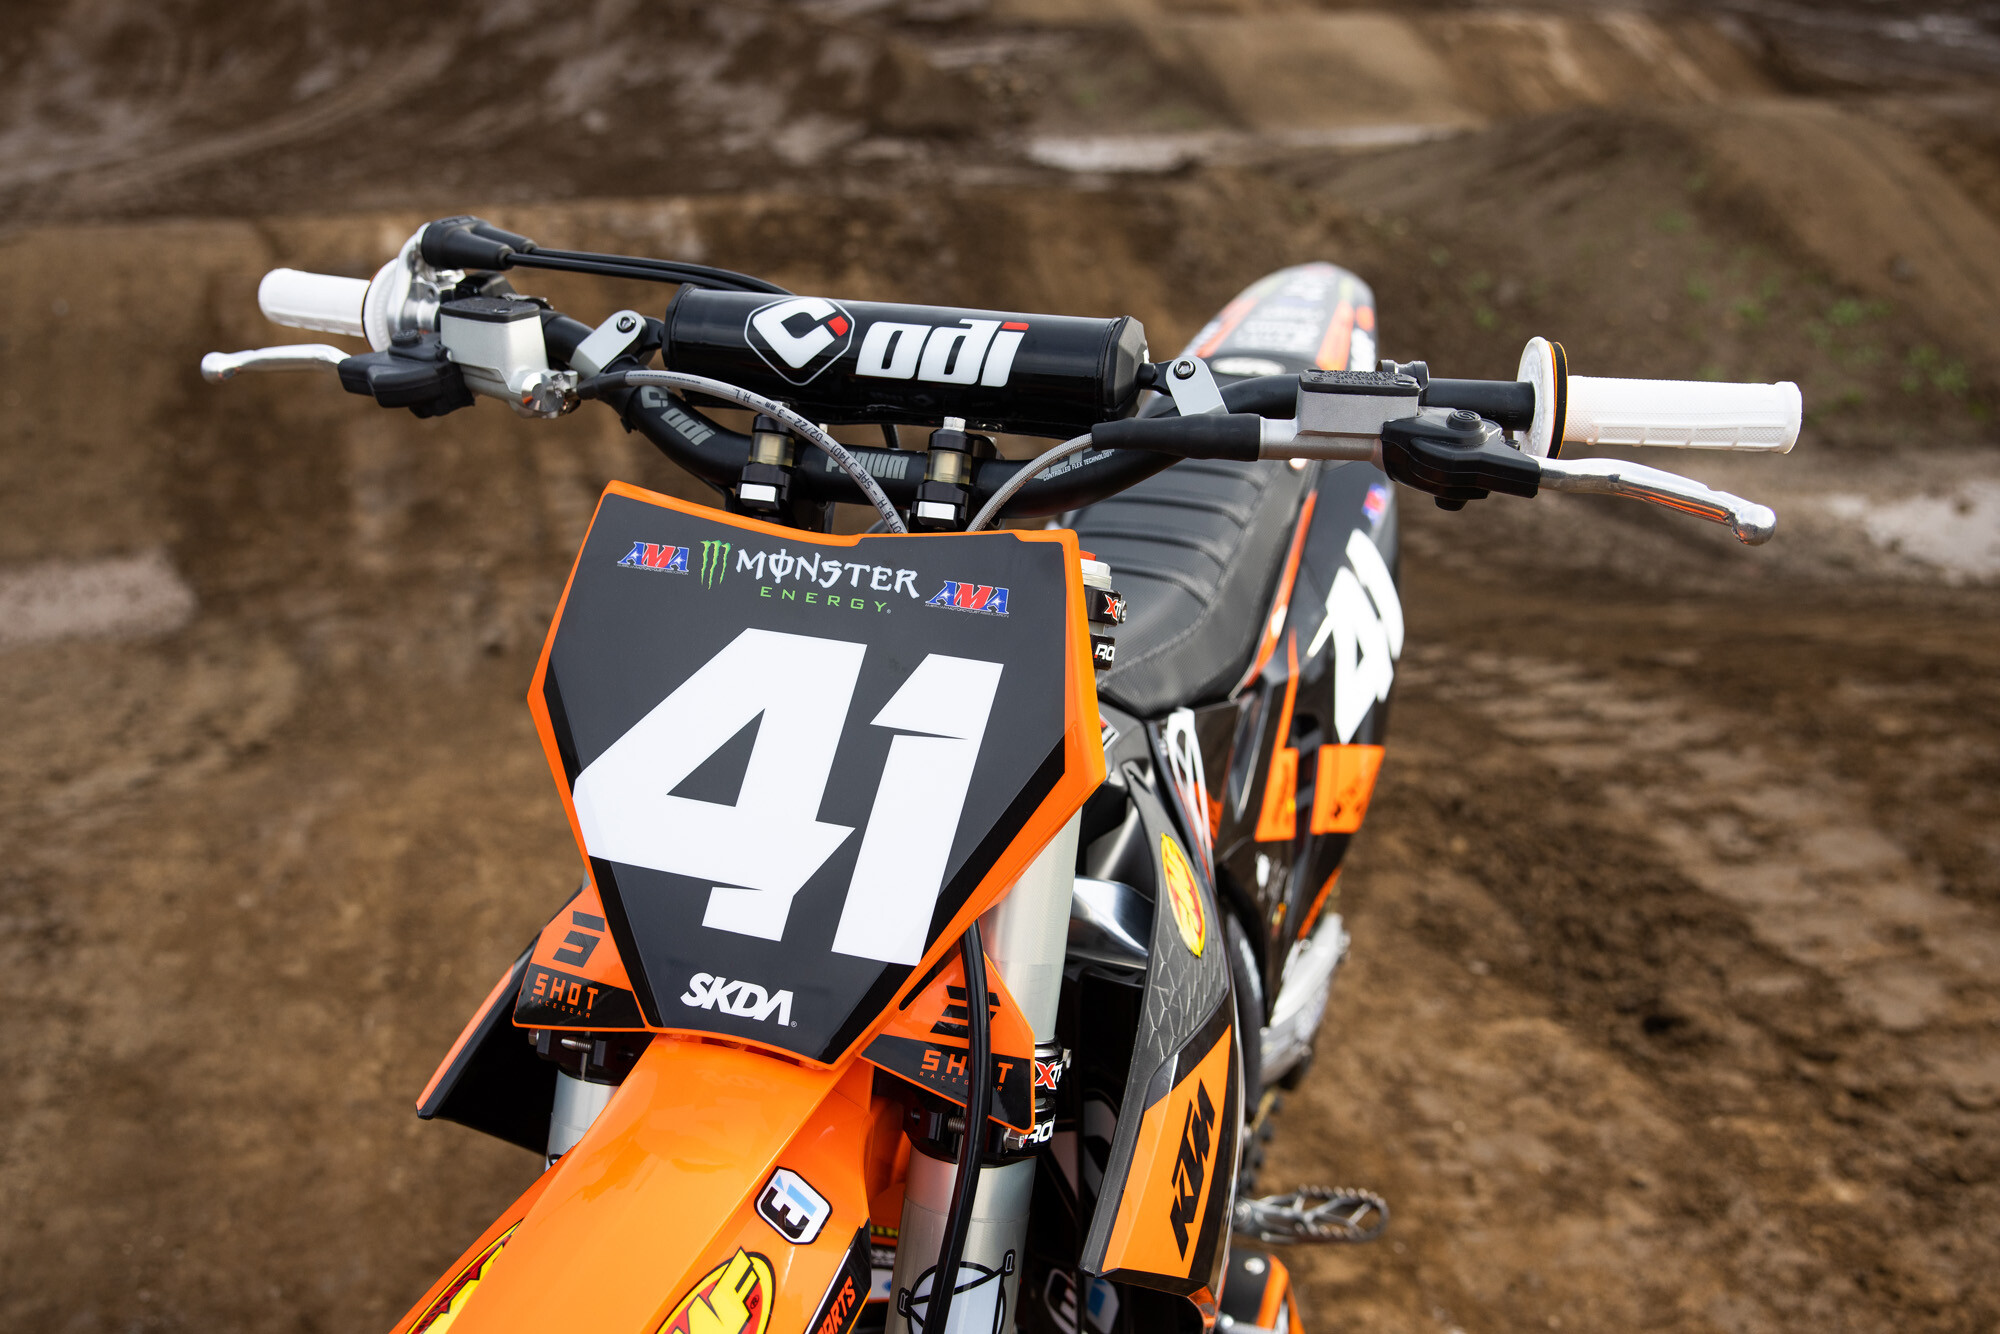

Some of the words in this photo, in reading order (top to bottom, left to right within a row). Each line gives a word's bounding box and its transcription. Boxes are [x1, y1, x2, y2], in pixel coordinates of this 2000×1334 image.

[856, 319, 1029, 387] odi
[855, 469, 874, 490] SAE
[1042, 465, 1072, 482] CONTROLLED
[1072, 461, 1083, 471] FLEX
[1083, 451, 1113, 466] TECHNOLOGY
[617, 541, 690, 573] AMA
[760, 586, 888, 613] ENERGY
[925, 580, 1010, 615] AMA
[573, 628, 1004, 966] 41
[530, 995, 591, 1019] RACEGEAR
[533, 972, 599, 1010] SHOT
[680, 972, 793, 1026] SKDA
[919, 1071, 1003, 1092] RACEGR
[921, 1049, 1014, 1084] SHT
[1170, 1078, 1216, 1262] KTM
[817, 1275, 856, 1334] ARTS
